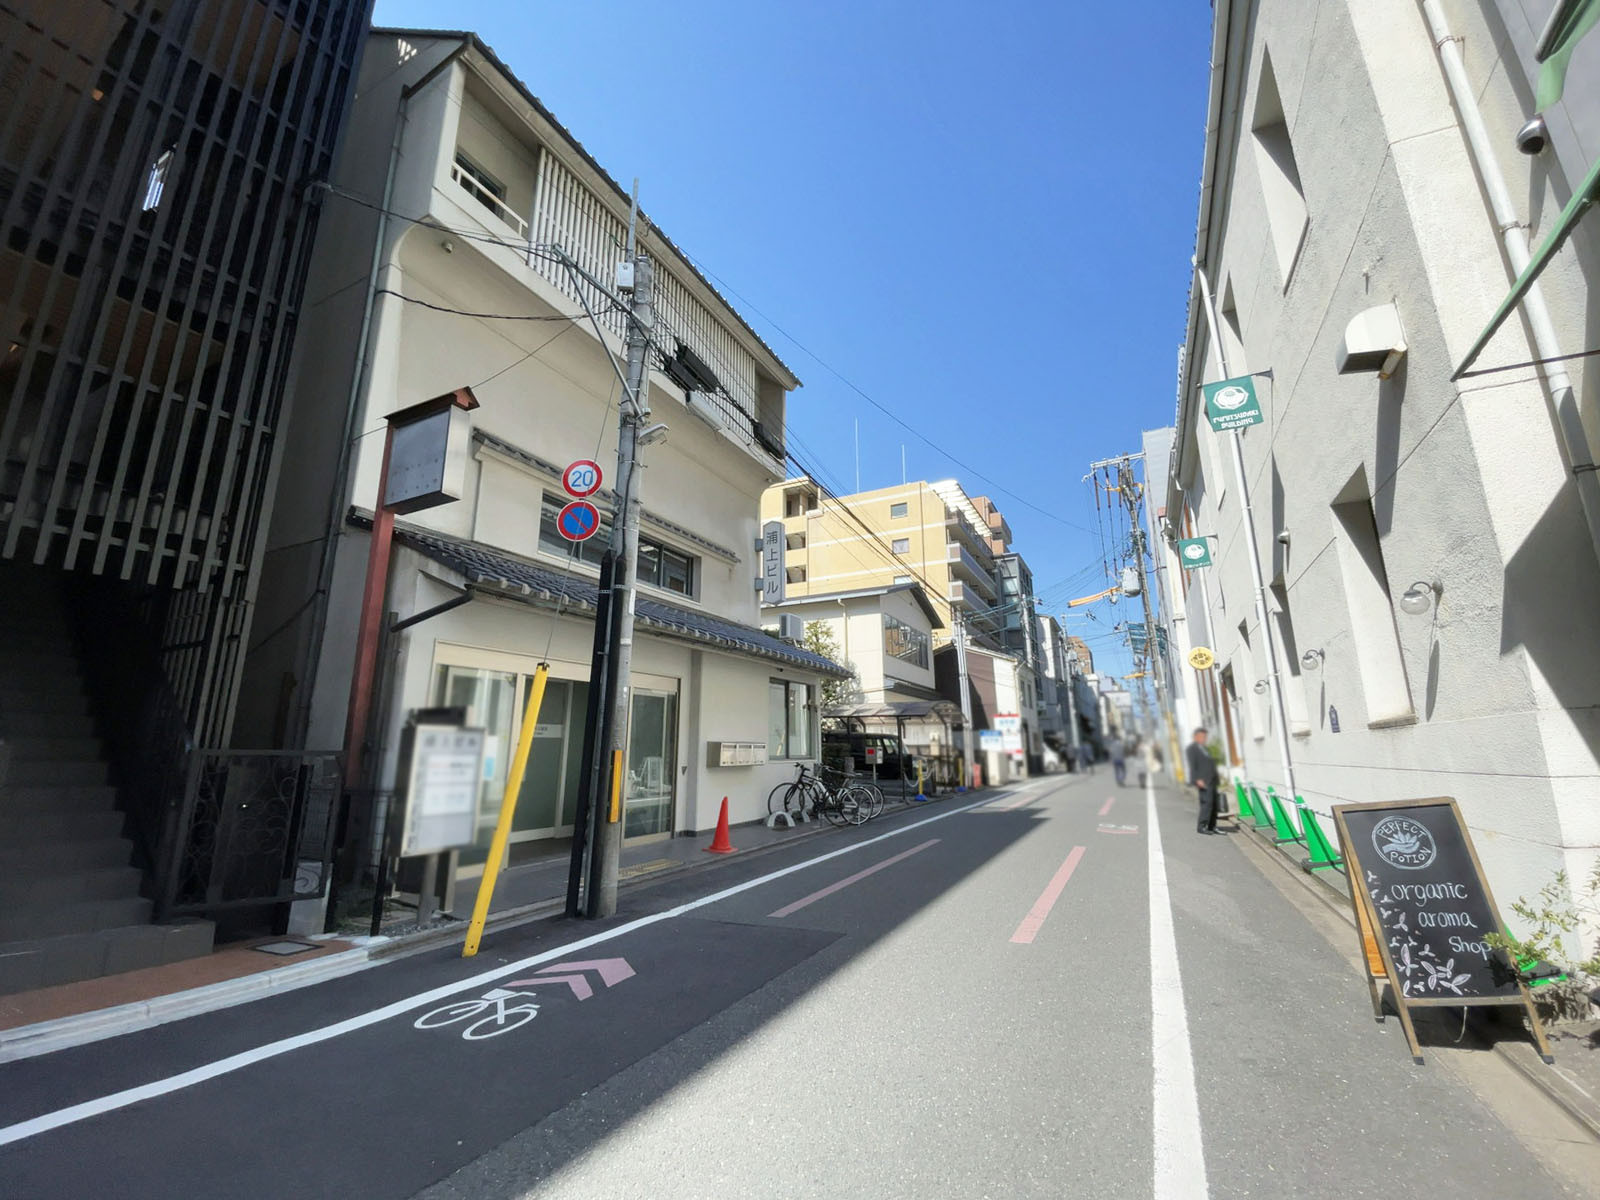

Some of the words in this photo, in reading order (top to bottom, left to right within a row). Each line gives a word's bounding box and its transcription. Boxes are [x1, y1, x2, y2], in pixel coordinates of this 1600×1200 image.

[571, 470, 594, 487] 20
[766, 530, 779, 594] 浦上ビル
[1377, 820, 1427, 838] PERFECT
[1390, 847, 1432, 863] POTION
[1391, 882, 1468, 907] organic
[1418, 911, 1478, 928] aroma
[1448, 936, 1492, 961] Shop
